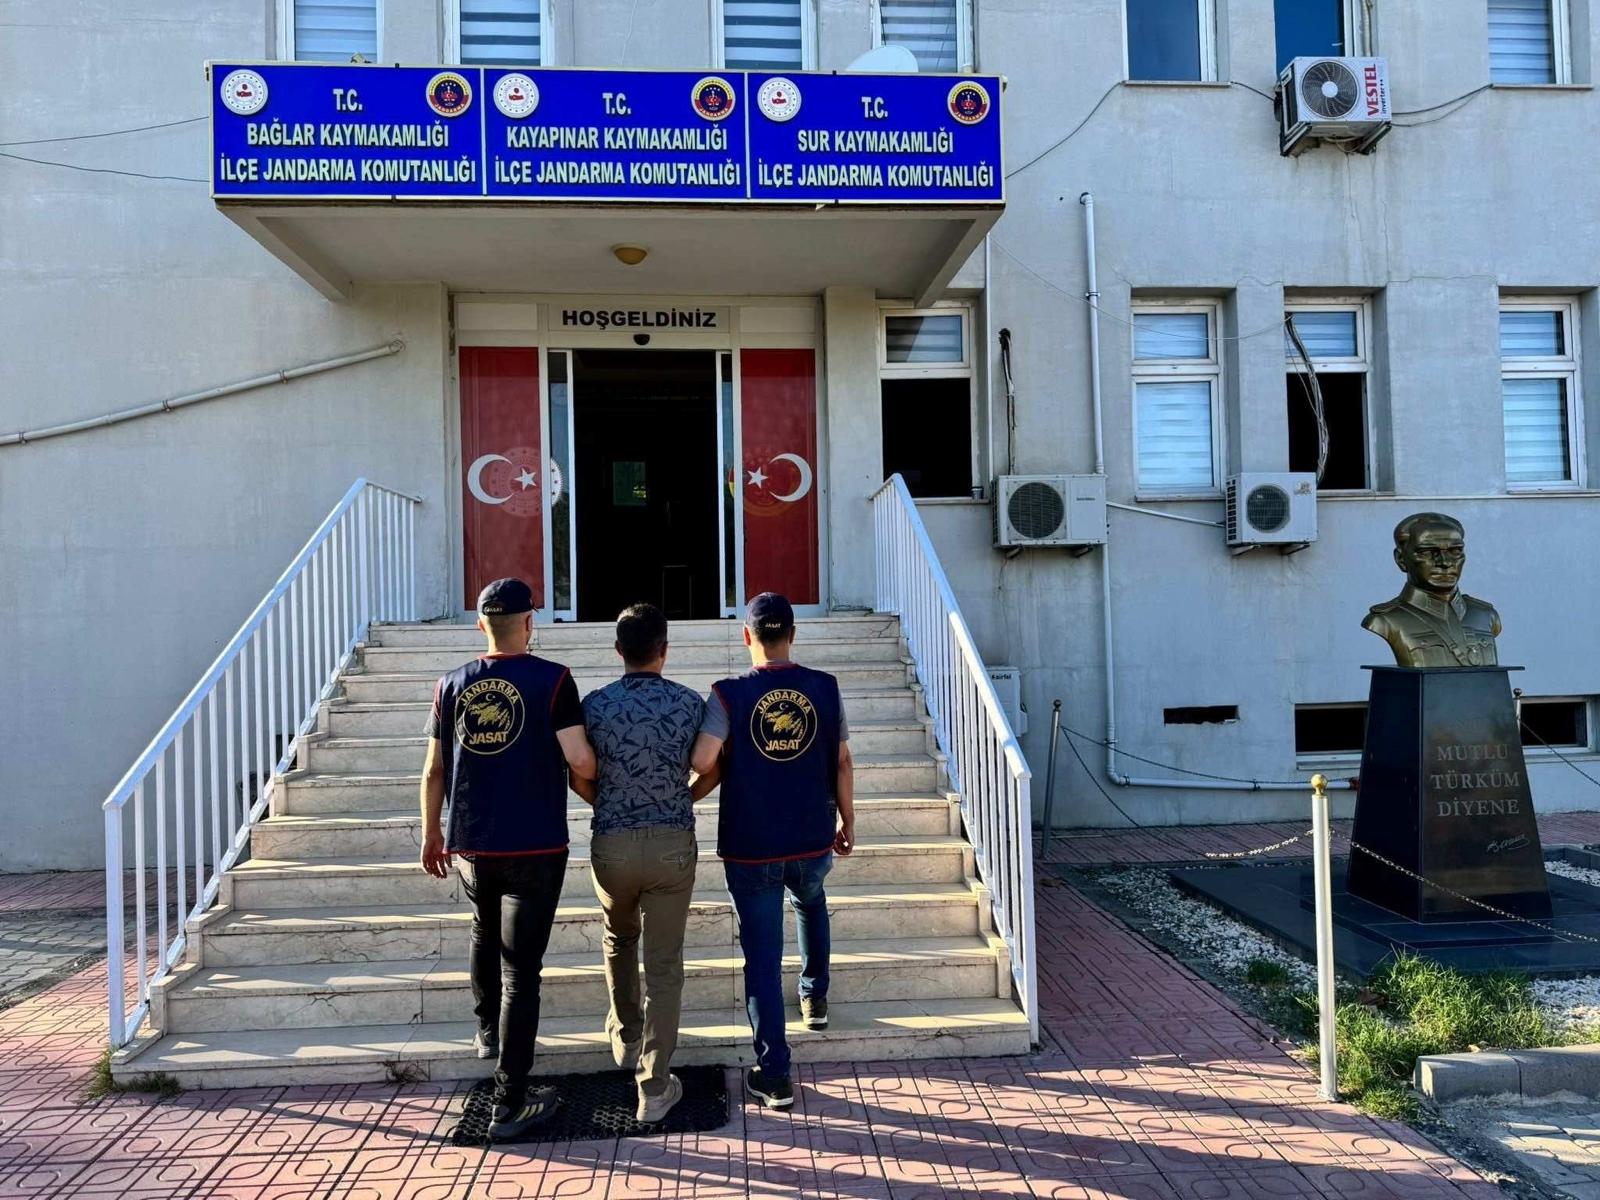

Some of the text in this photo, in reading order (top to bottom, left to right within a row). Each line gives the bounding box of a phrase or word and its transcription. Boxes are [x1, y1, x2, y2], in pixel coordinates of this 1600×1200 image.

[333, 88, 363, 112] T.C.
[1364, 63, 1379, 117] VESTEL
[602, 92, 632, 115] T.C.
[861, 96, 889, 119] T.C.
[246, 117, 449, 147] BAĞLAR KAYMAKAMLIĞI
[506, 123, 728, 150] KAYAPINAR KAYMAKAMLIĞI
[797, 127, 954, 153] SUR KAYMAKAMLIĞI
[220, 152, 476, 183] İLÇE JANDARMA KOMUTANLIĞI
[495, 155, 741, 185] İLÇE JANDARMA KOMUTANLIĞI
[758, 157, 994, 187] İLÇE JANDARMA KOMUTANLIĞI
[562, 308, 717, 330] HOŞGELDİNİZ
[461, 681, 518, 706] JANDARMA
[758, 691, 811, 714] JANDARMA
[469, 731, 508, 745] JASAT
[765, 739, 801, 751] JASAT
[1437, 744, 1509, 761] MUTLU
[1431, 769, 1520, 790] TÜRKÜM
[1437, 797, 1520, 817] DİYENE
